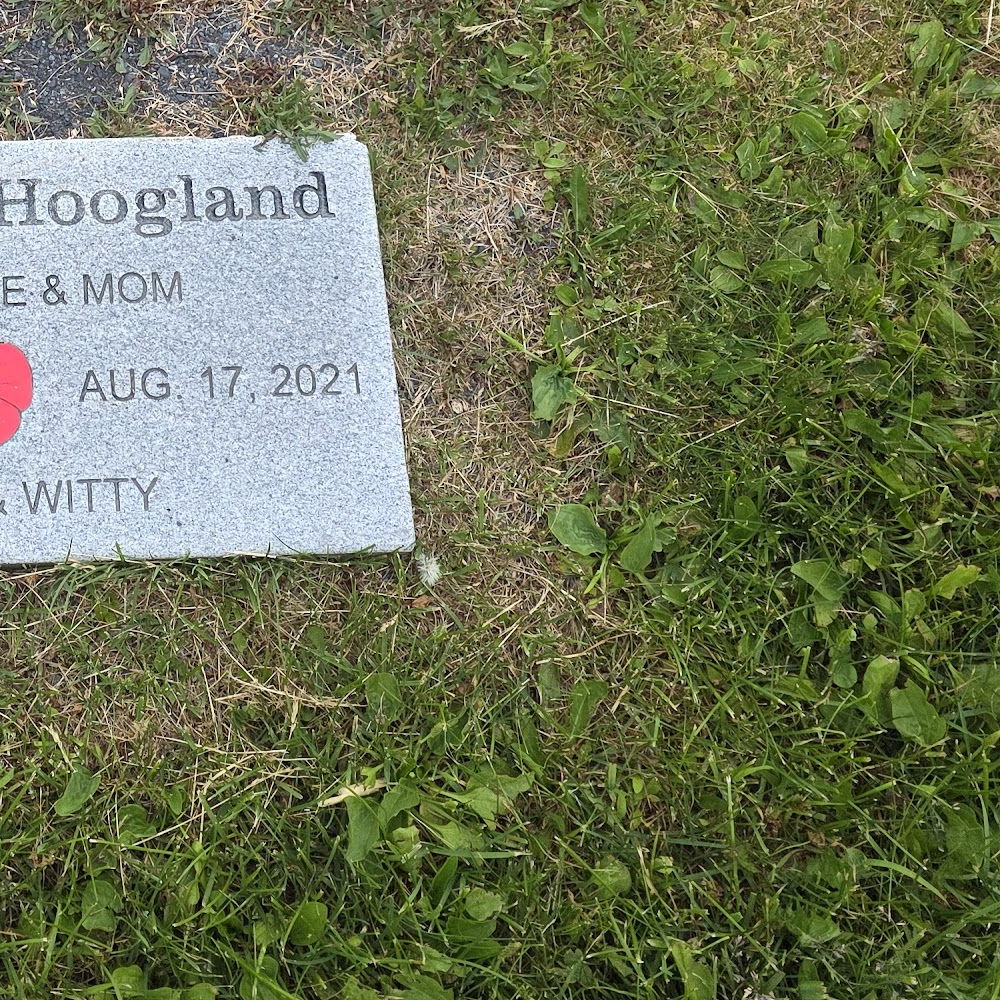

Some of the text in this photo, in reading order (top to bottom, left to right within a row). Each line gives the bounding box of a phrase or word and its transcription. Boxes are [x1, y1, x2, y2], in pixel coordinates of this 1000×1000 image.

[42, 274, 68, 306] &
[82, 271, 183, 305] MOM
[79, 367, 183, 402] AUG.
[200, 366, 256, 404] 17,
[271, 361, 362, 398] 2021
[21, 477, 159, 515] WITTY
